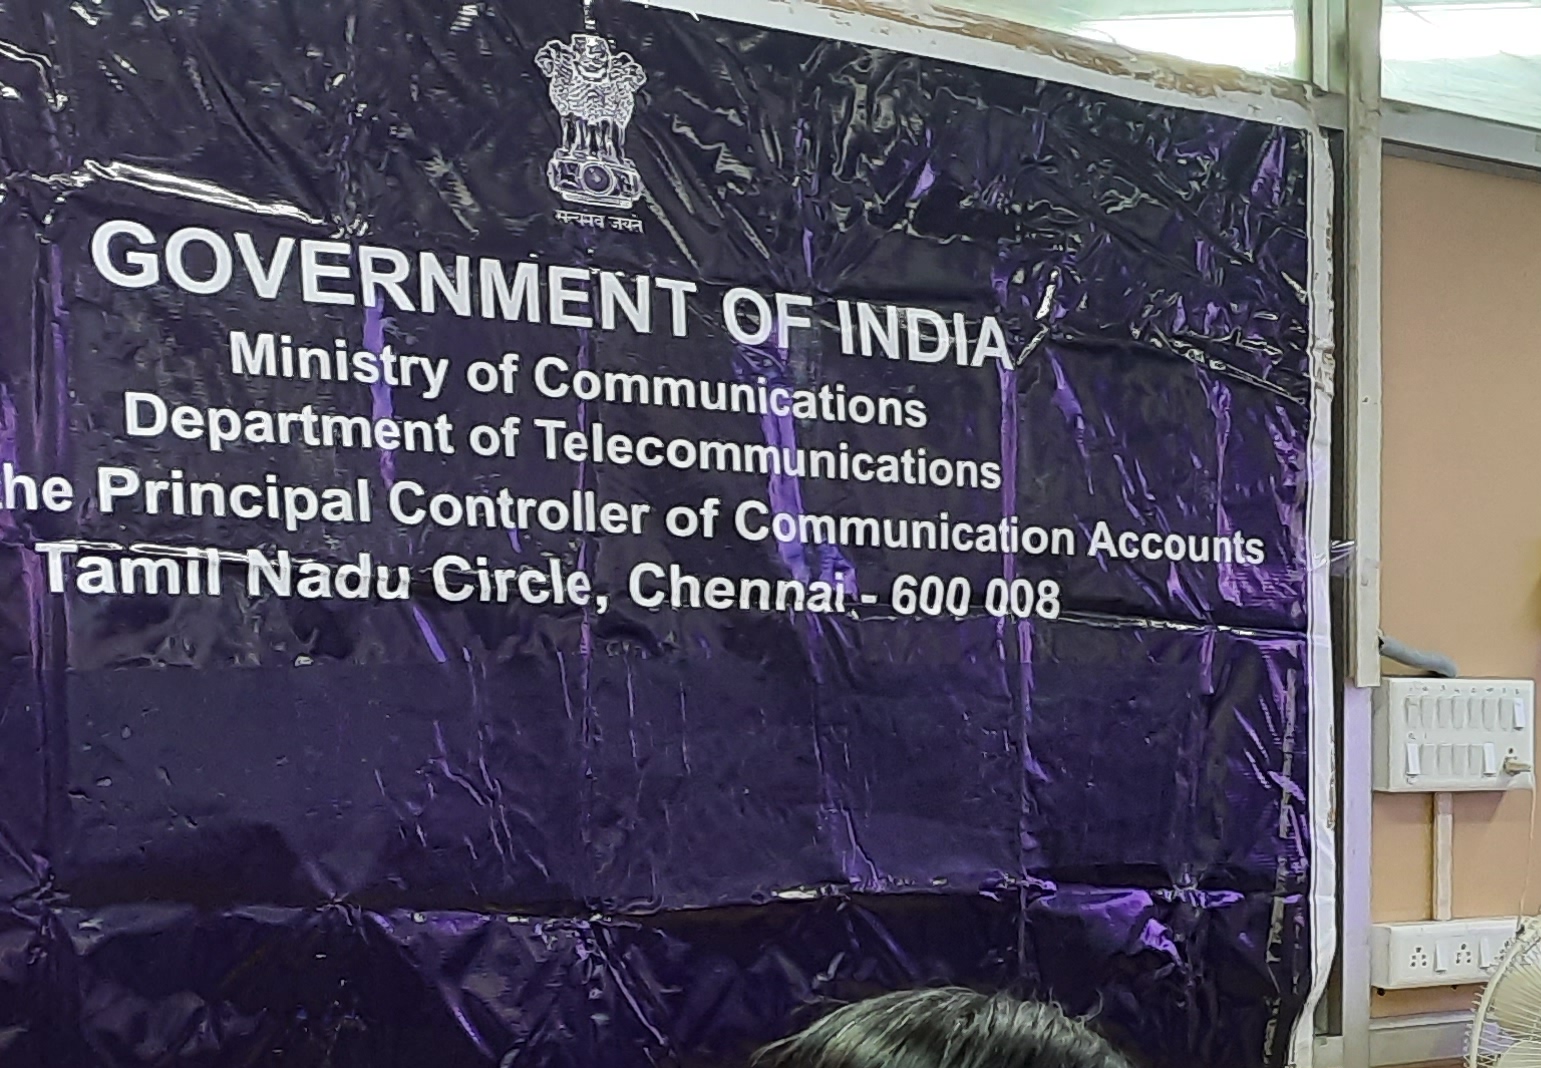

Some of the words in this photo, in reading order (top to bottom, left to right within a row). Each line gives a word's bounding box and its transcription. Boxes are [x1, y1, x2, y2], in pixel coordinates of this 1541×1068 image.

[90, 219, 697, 337] GOVERNMENT
[722, 286, 813, 349] OF
[838, 299, 1015, 371] INDIA
[229, 331, 449, 399] Ministry
[466, 353, 520, 396] of
[534, 356, 927, 428] Communications
[124, 391, 455, 455] Department
[469, 416, 520, 458] of
[534, 417, 1002, 490] Telecommunications
[0, 463, 73, 512] he
[99, 465, 371, 531] Principal
[389, 480, 650, 536] Controller
[665, 496, 720, 538] of
[734, 499, 1075, 557] Communication
[1088, 521, 1265, 565] Accounts
[36, 541, 221, 596] Tamil
[246, 548, 410, 601] Nadu
[431, 554, 609, 614] Circle,
[628, 562, 847, 614] Chennai
[892, 574, 971, 619] 600
[985, 578, 1061, 619] 008
